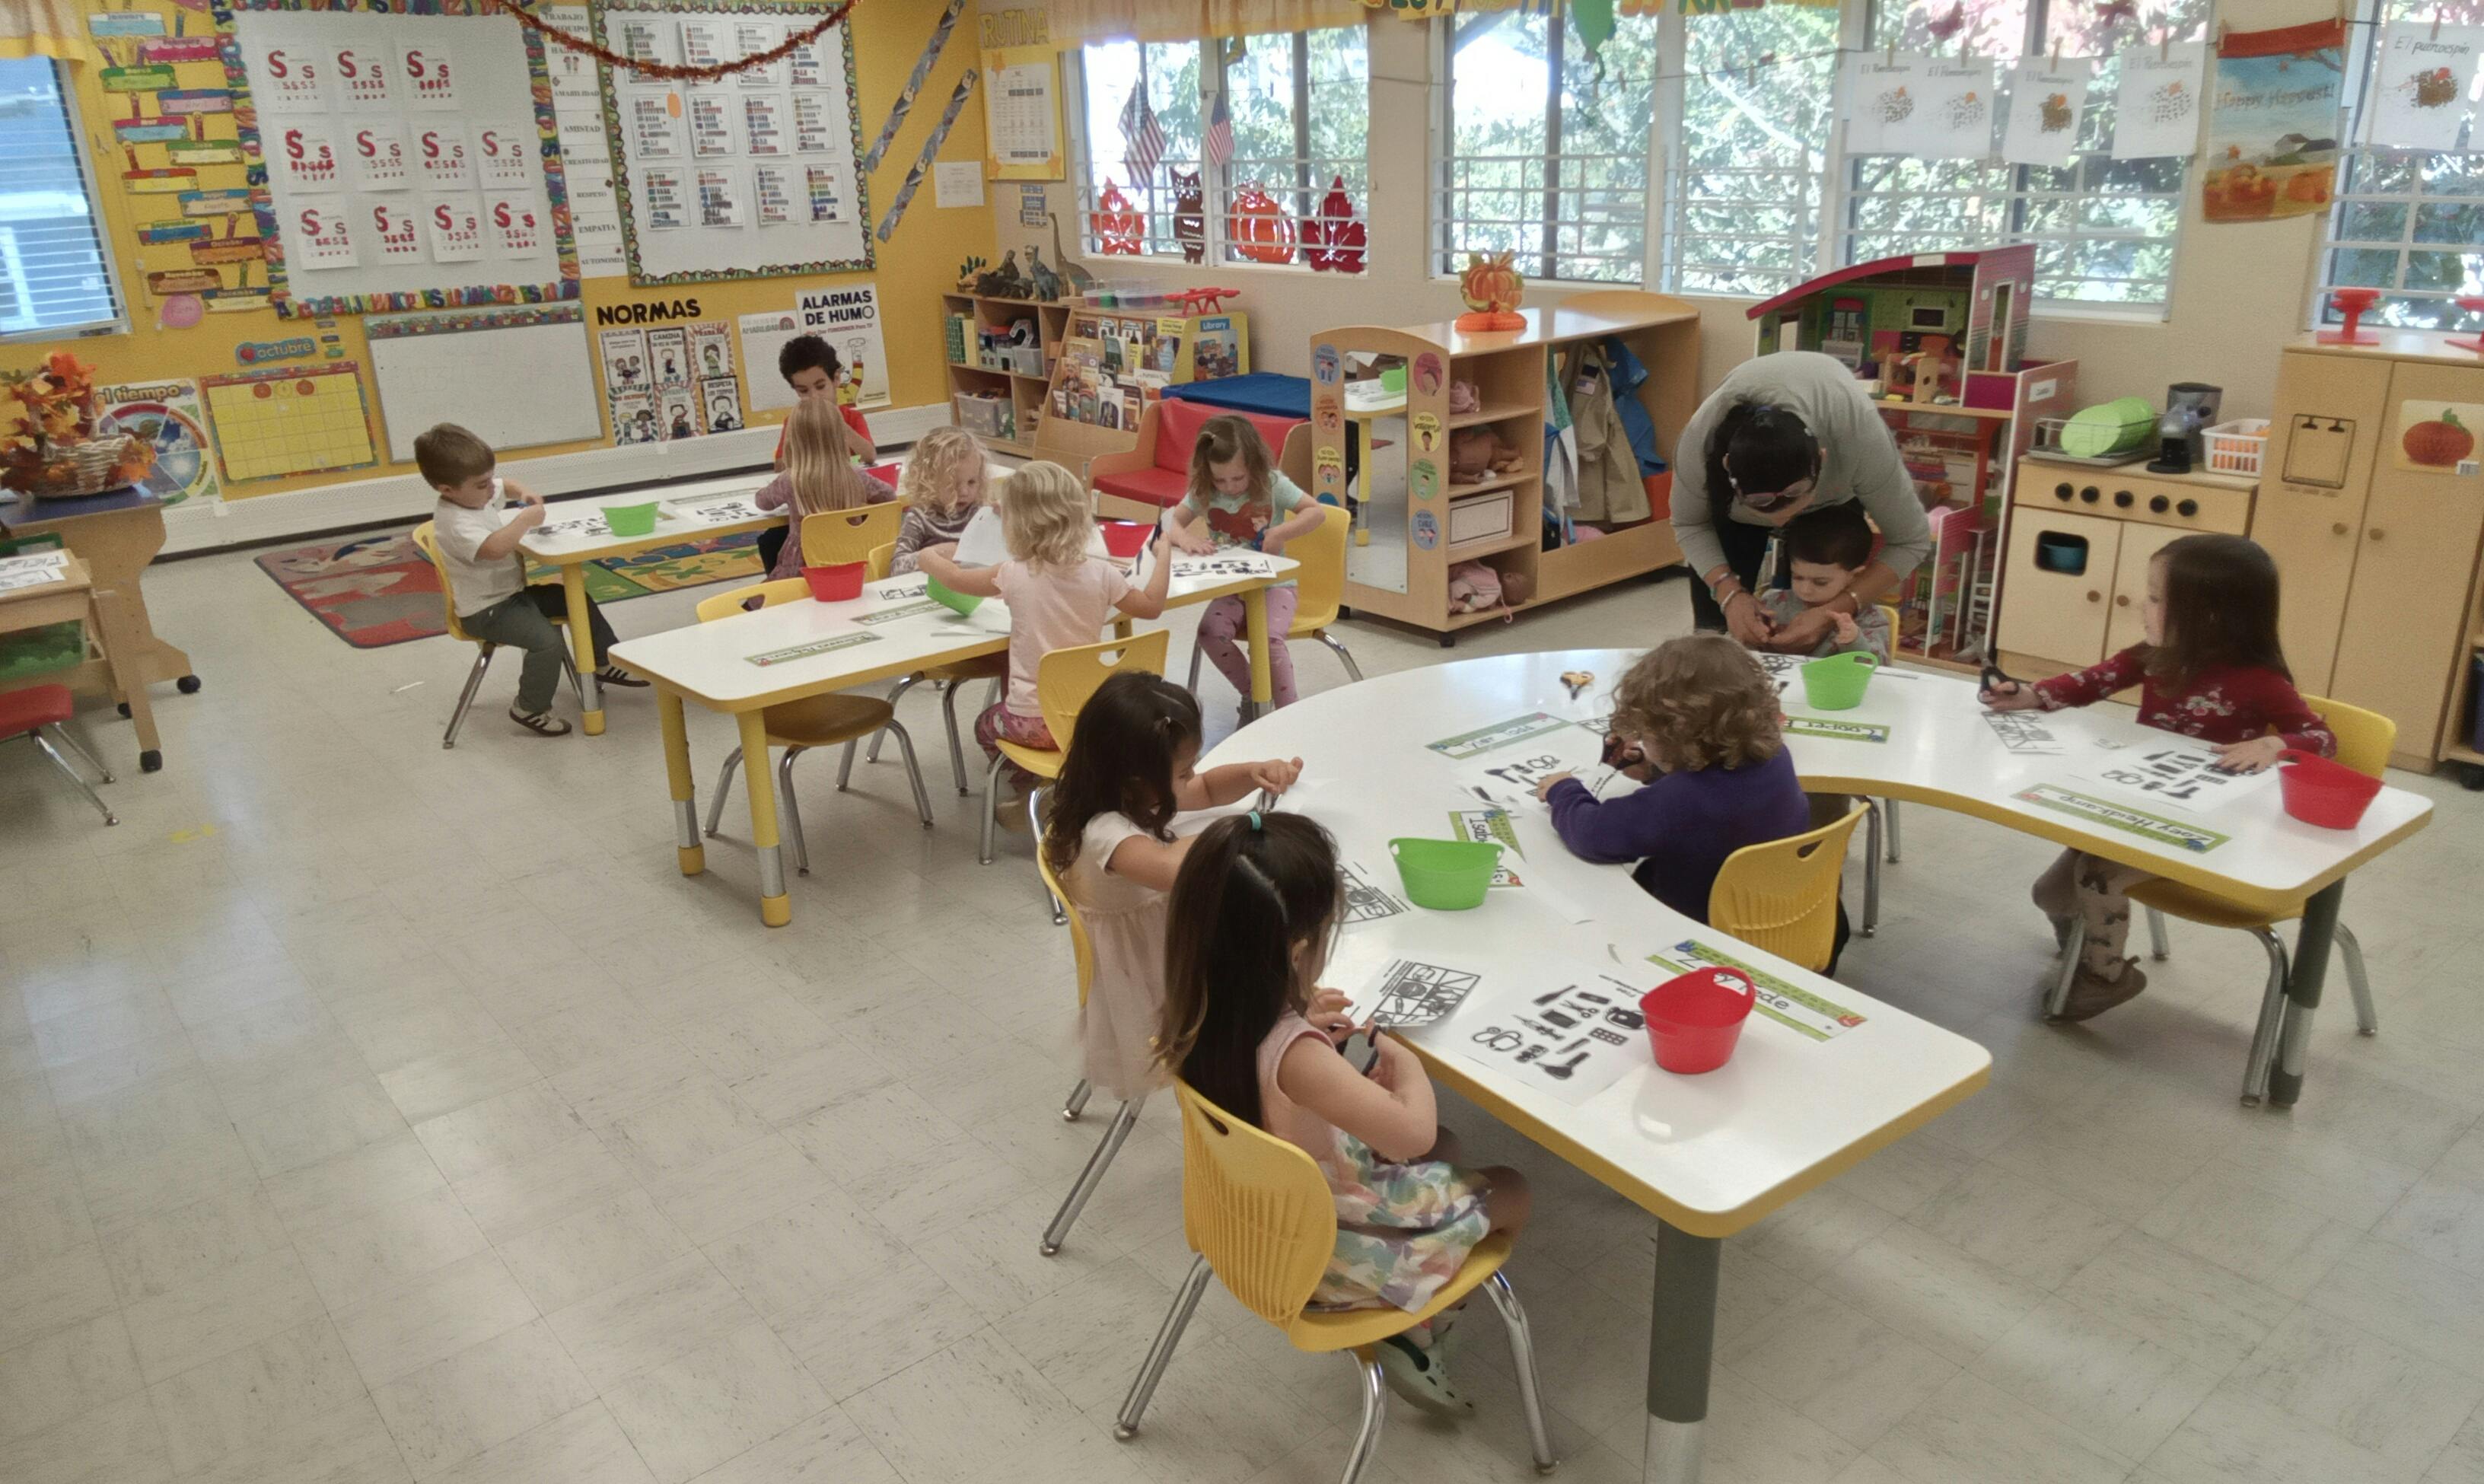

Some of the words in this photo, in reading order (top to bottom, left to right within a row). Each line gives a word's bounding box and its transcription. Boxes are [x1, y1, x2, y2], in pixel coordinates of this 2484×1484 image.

[269, 50, 287, 78] S
[338, 51, 356, 78] S
[406, 50, 424, 78] S
[285, 129, 304, 158] S
[357, 130, 375, 157] S
[422, 132, 439, 158] S
[482, 131, 498, 156] S
[301, 209, 321, 235] S
[374, 206, 389, 232] S
[435, 205, 452, 230] S
[494, 202, 511, 228] S
[597, 298, 702, 326] NORMAS
[802, 290, 873, 310] ALARMAS
[804, 310, 826, 326] DE
[829, 304, 875, 323] HUMO
[1202, 320, 1227, 330] Library
[257, 340, 314, 358] octubre
[115, 384, 181, 404] tiempo
[2156, 824, 2210, 842] Zoey
